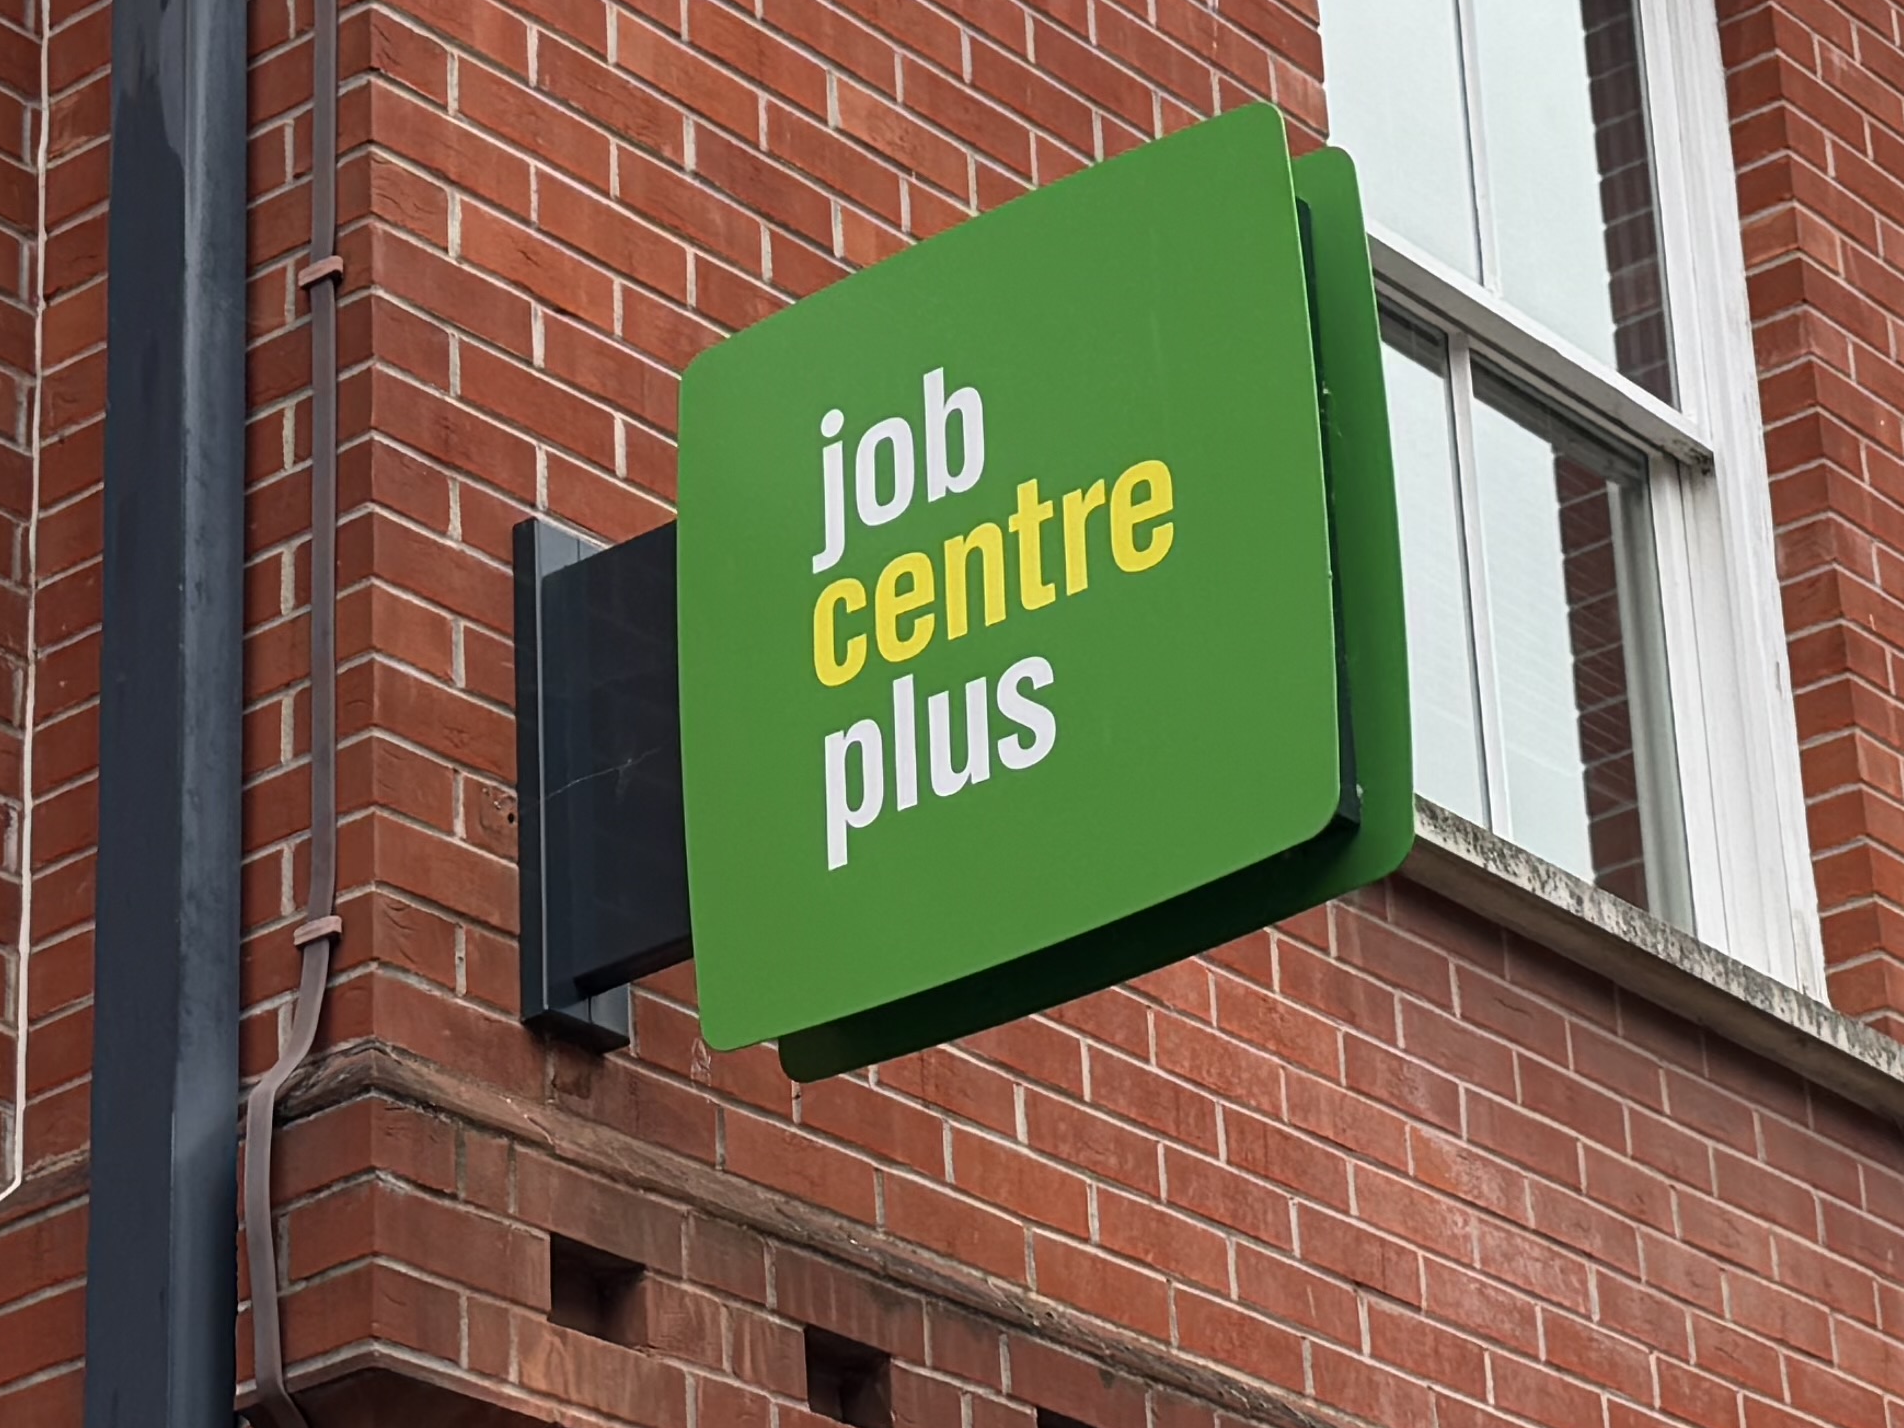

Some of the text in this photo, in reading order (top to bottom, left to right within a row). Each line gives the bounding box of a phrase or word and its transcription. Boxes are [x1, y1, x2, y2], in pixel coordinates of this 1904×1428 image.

[810, 366, 986, 575] job
[811, 458, 1175, 688] centre
[823, 655, 1058, 872] plus
